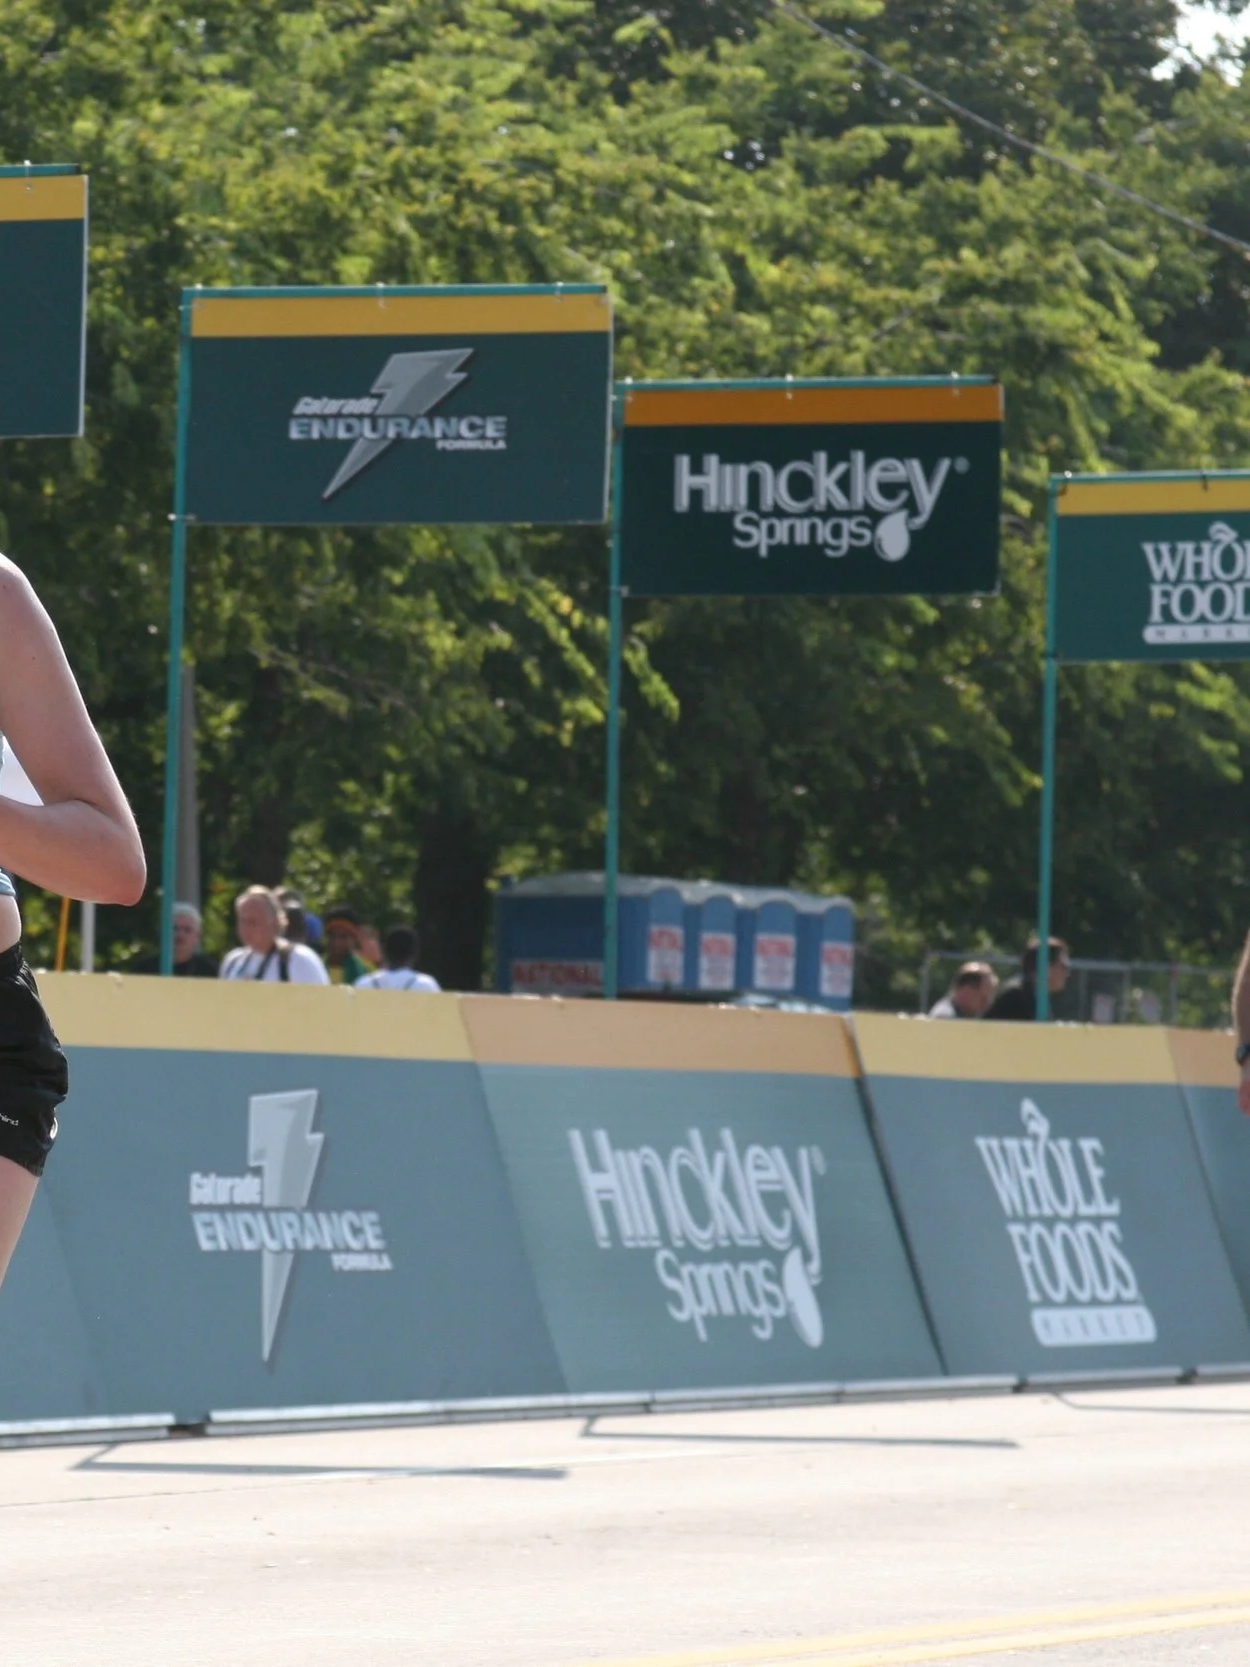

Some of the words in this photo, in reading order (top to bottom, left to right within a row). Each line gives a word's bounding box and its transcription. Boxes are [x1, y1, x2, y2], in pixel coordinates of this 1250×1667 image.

[288, 415, 508, 441] ENDURANCE
[673, 450, 952, 531] Hinckley
[733, 511, 874, 559] Springs
[567, 1126, 824, 1287] Hinckley
[975, 1135, 1121, 1219] WHOLE
[192, 1209, 387, 1252] ENDURANCE
[1006, 1221, 1137, 1303] FOODS
[655, 1249, 787, 1343] Springs
